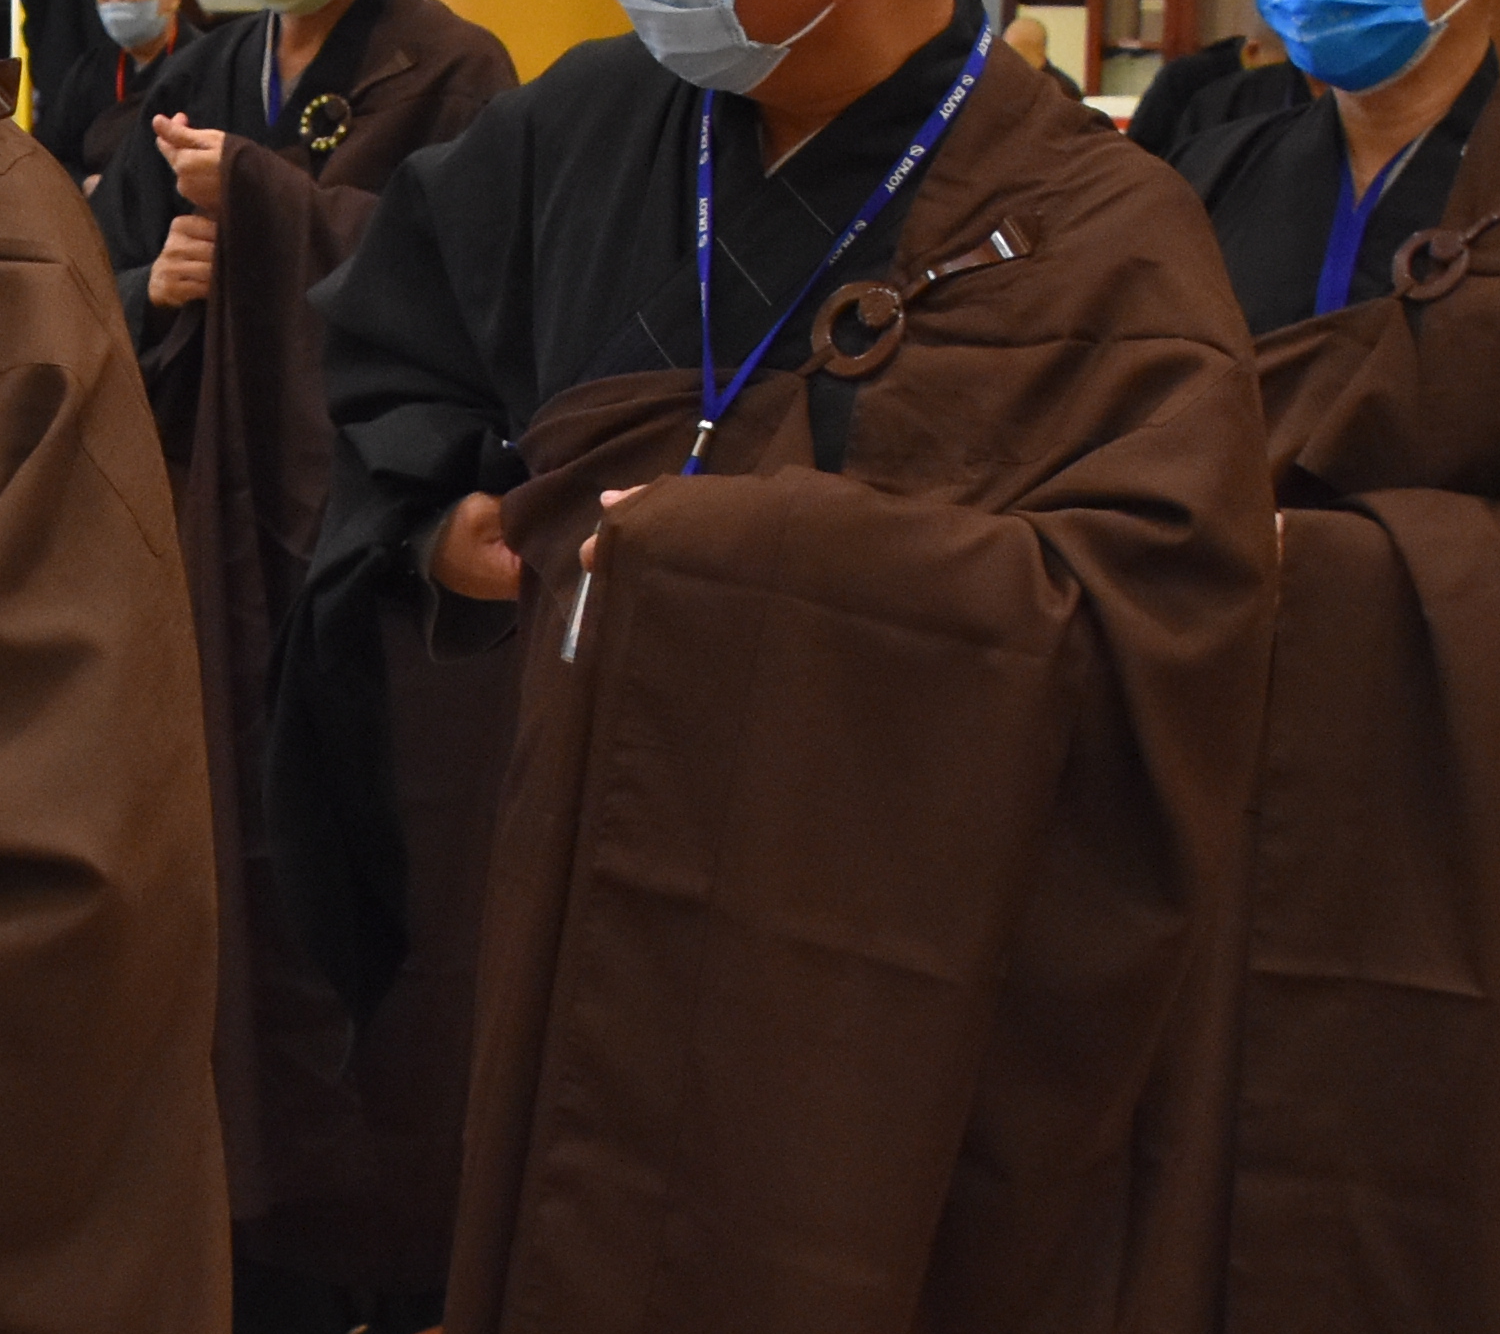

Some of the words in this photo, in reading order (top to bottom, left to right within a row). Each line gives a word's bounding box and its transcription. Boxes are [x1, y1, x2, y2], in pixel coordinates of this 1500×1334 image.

[939, 85, 966, 122] ENJOY
[885, 155, 915, 195] ENJOY
[698, 196, 709, 233] ENJOY
